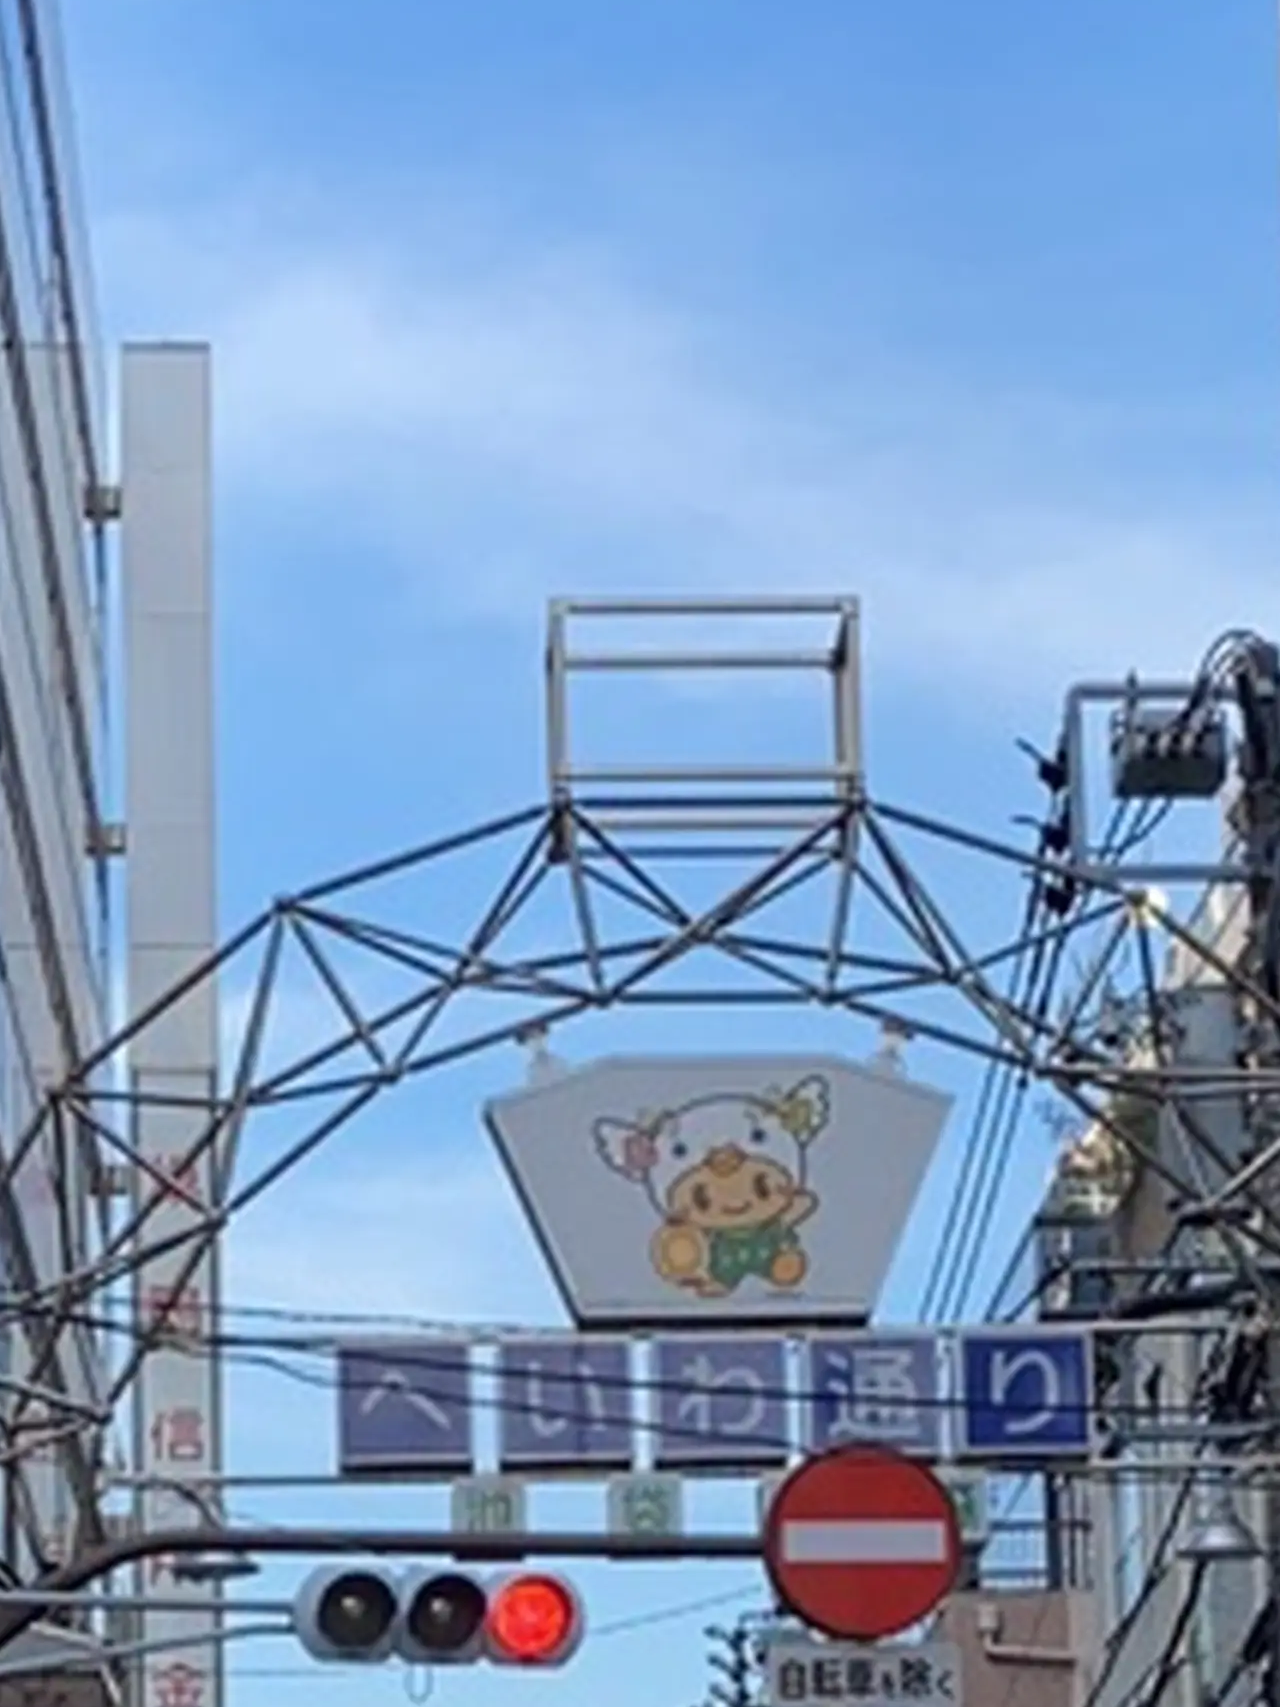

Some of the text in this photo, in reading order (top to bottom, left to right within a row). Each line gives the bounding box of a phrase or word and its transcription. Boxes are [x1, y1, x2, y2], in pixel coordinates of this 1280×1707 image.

[360, 1346, 1060, 1443] へいわ通り
[778, 1655, 956, 1699] 自転車を除く
